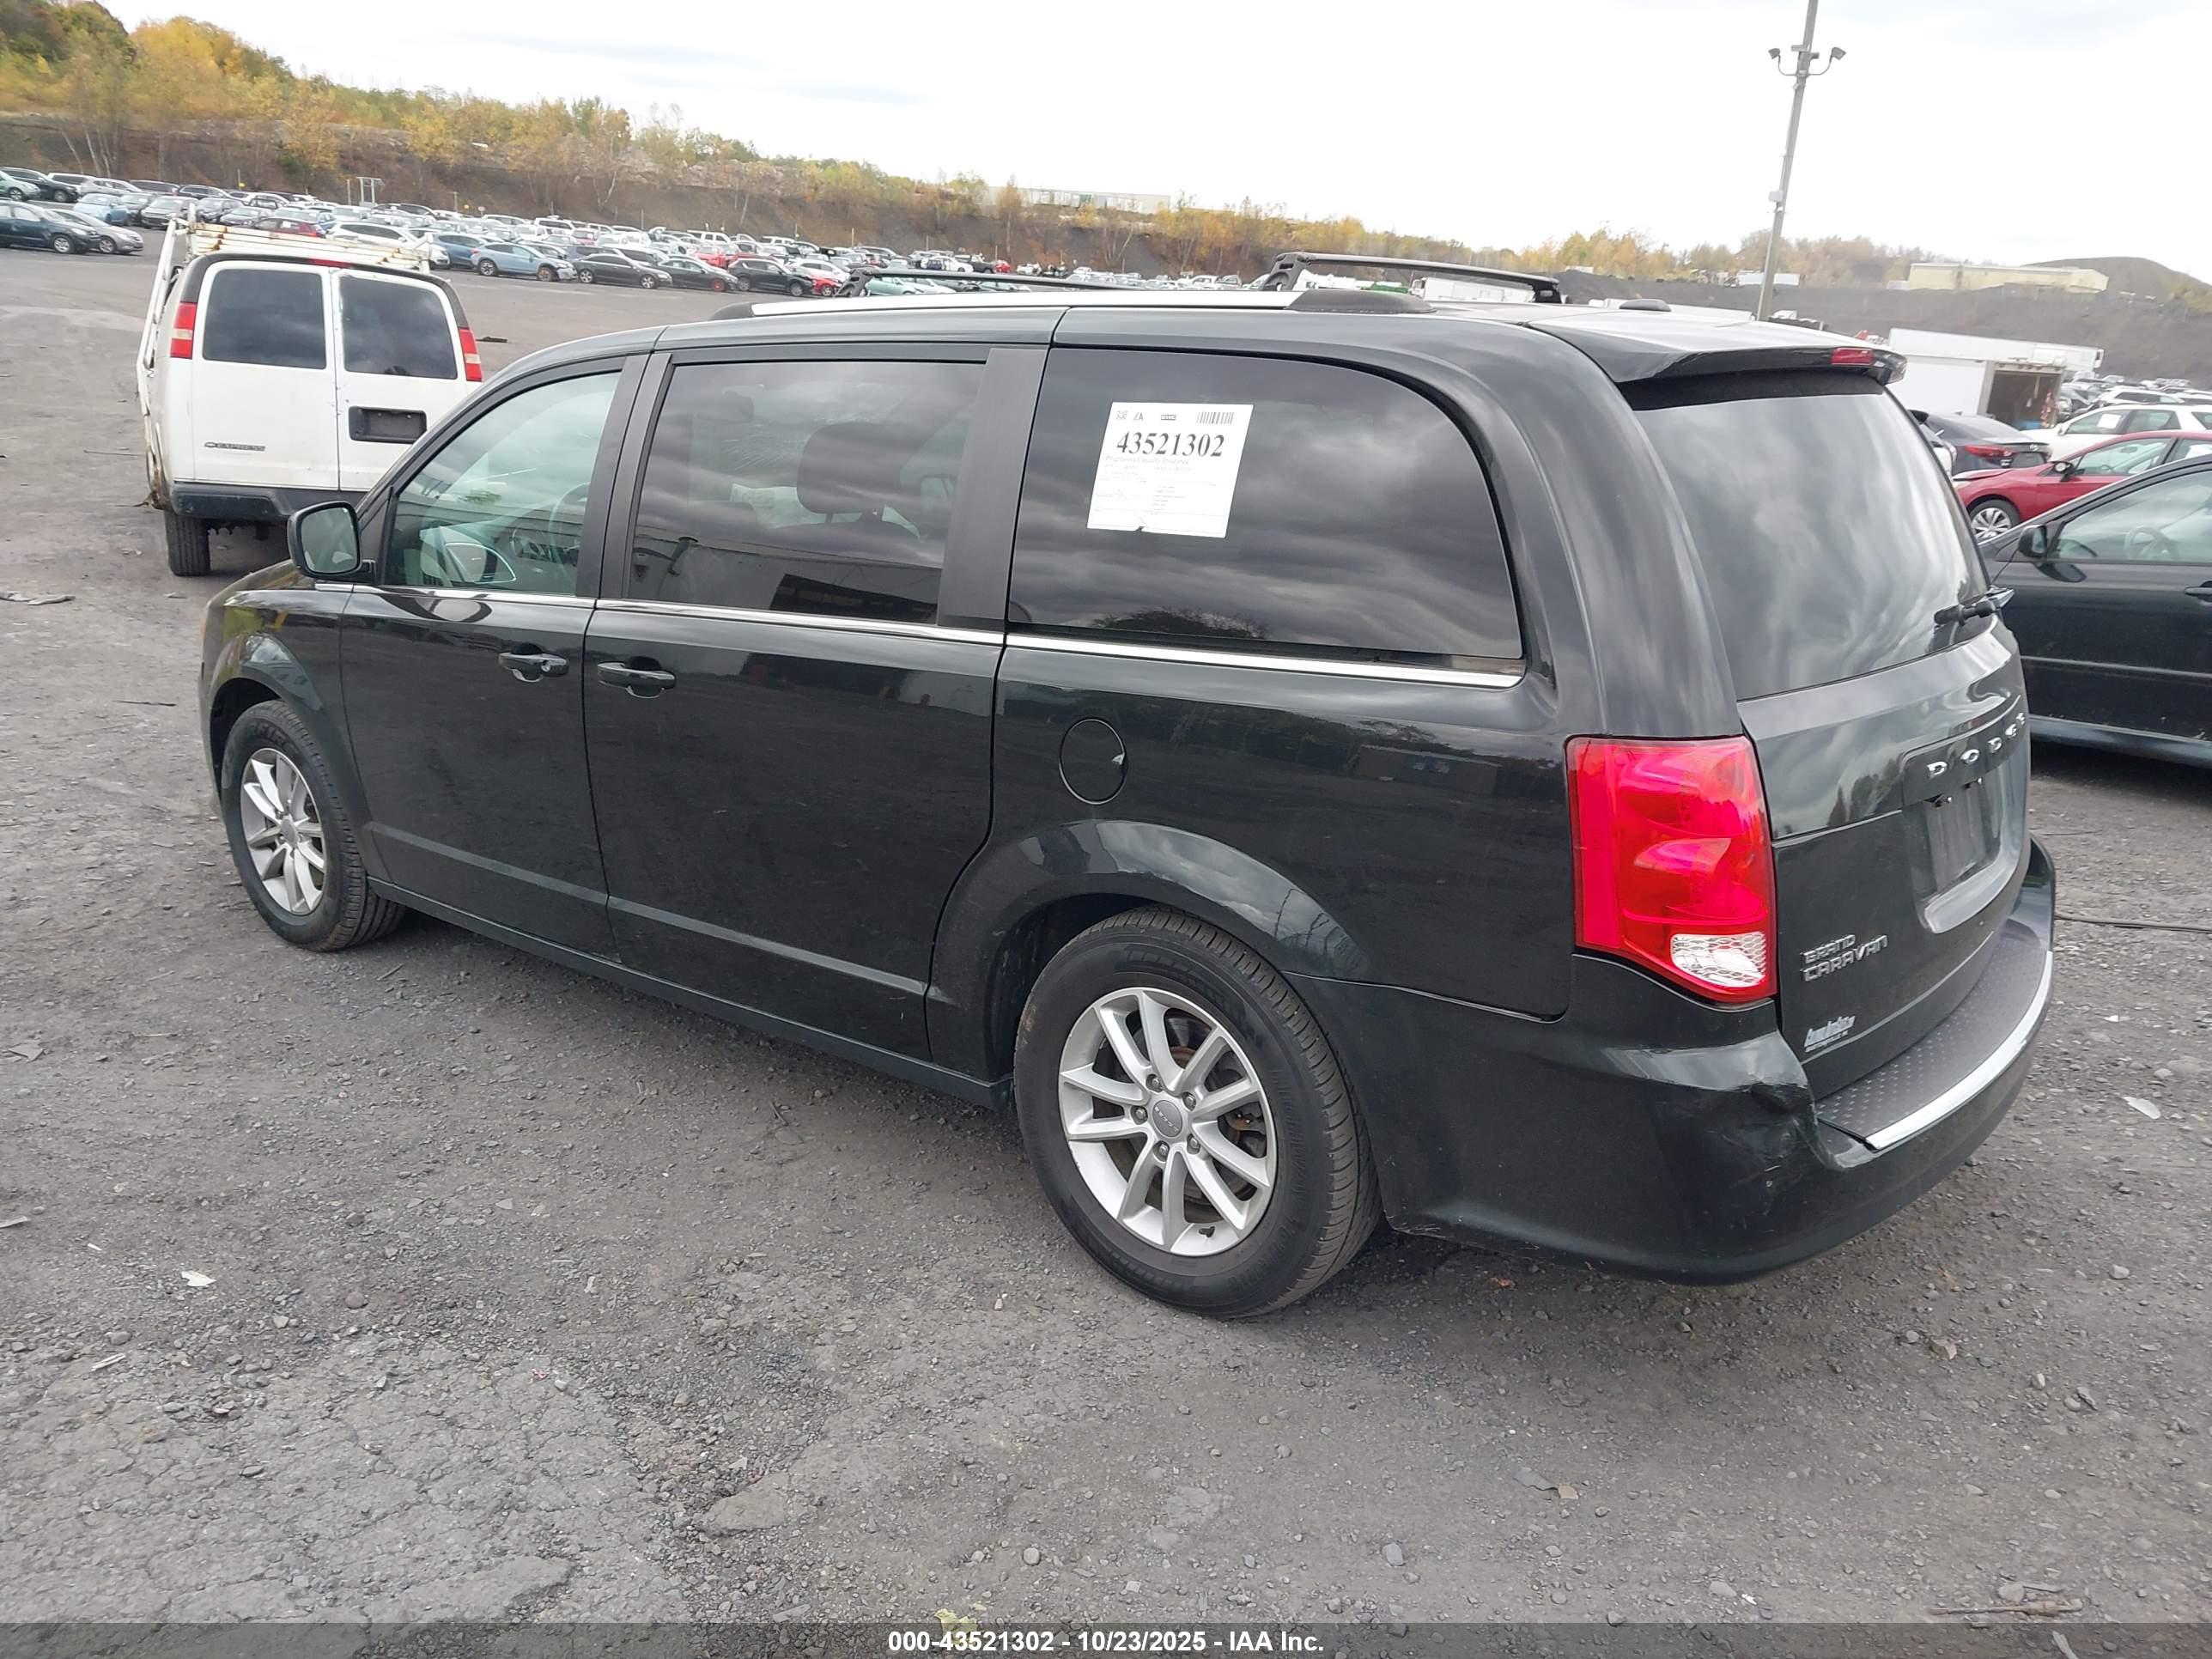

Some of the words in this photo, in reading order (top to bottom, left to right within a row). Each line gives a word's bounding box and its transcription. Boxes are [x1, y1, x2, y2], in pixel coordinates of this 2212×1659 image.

[1116, 431, 1224, 457] 43521302
[1801, 934, 1856, 963] GRAND
[1801, 935, 1888, 981] CARAVAN
